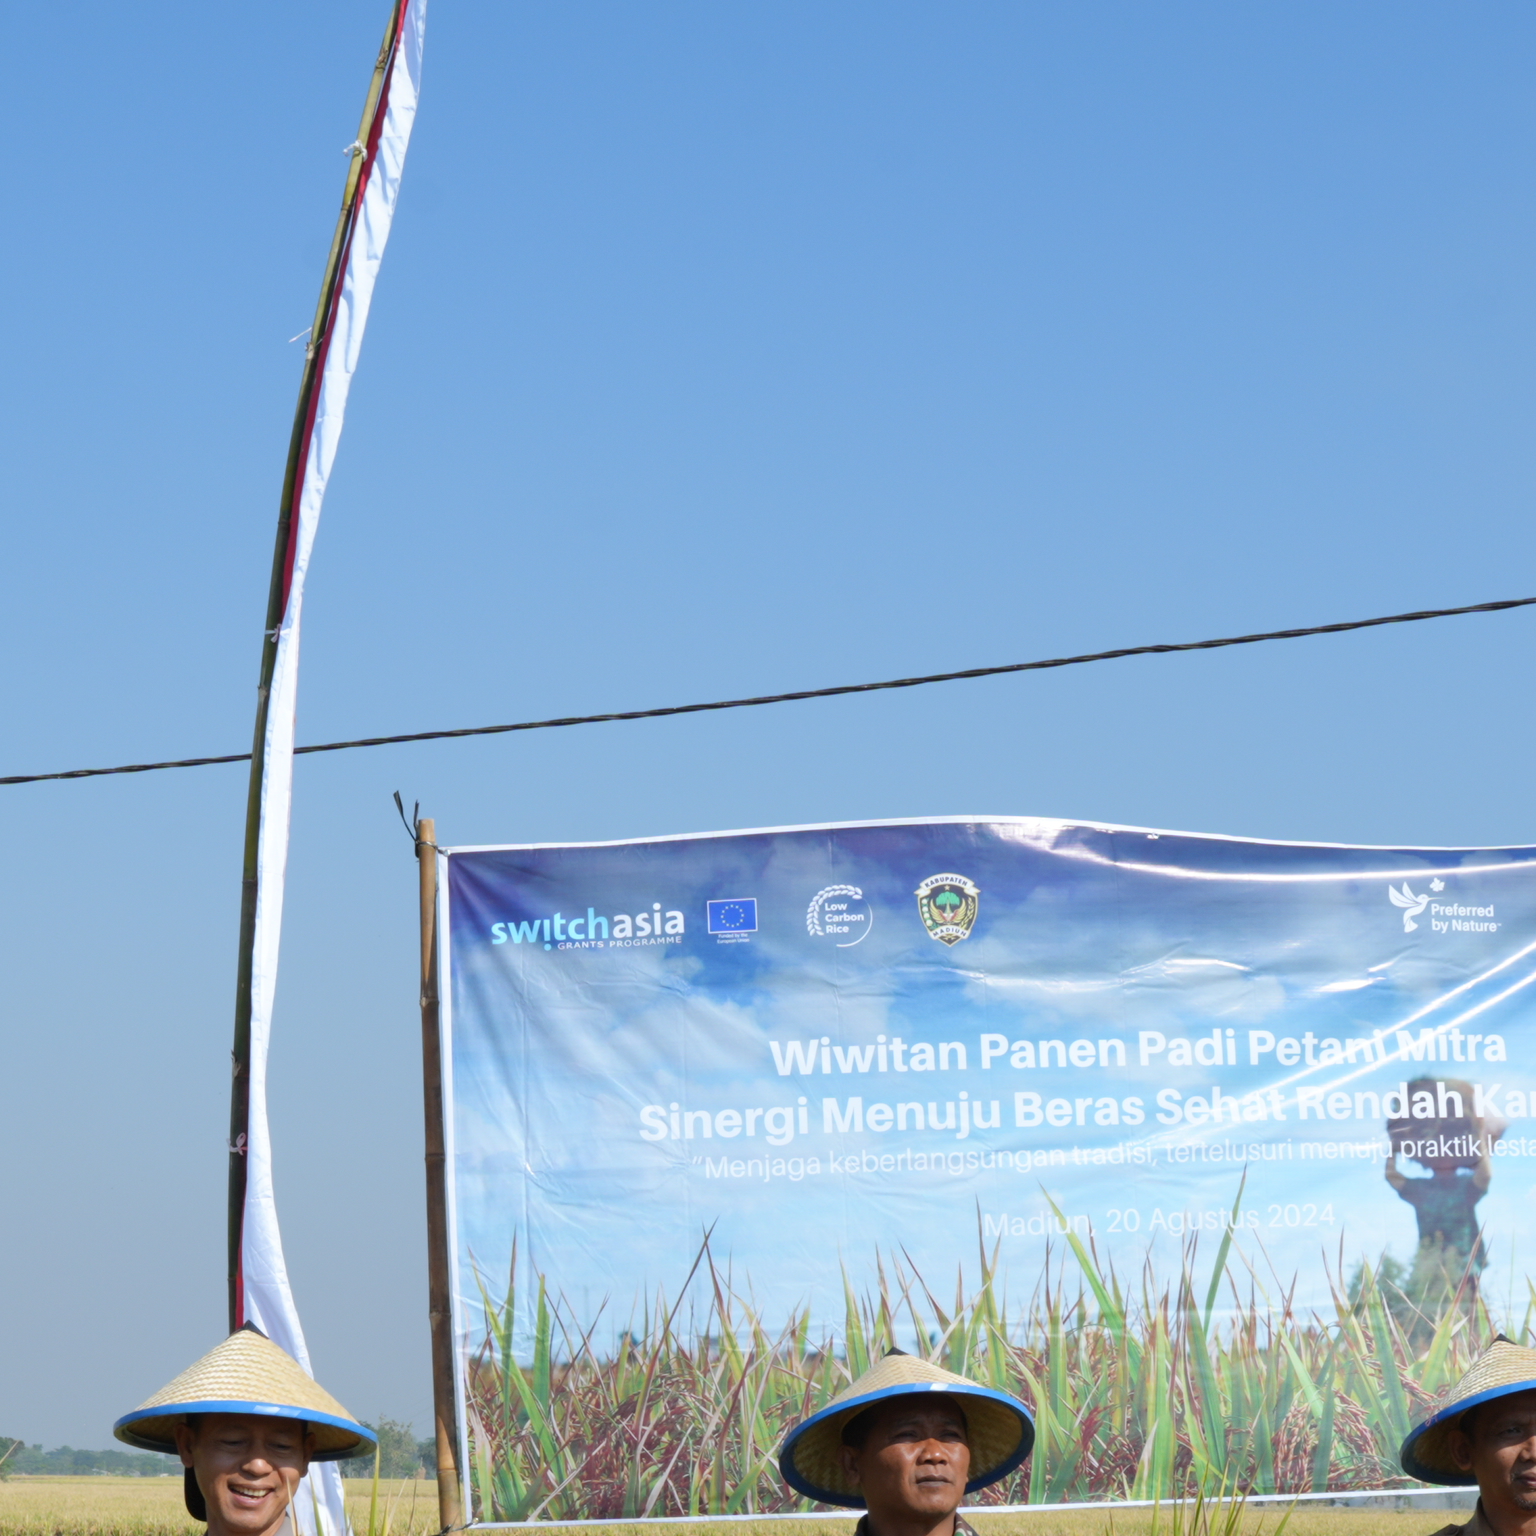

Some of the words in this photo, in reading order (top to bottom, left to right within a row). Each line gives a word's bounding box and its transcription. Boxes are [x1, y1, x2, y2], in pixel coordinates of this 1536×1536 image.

[925, 876, 968, 889] KABUPATEN
[825, 903, 847, 911] Low
[1431, 903, 1494, 917] Preferred
[825, 913, 864, 922] Carbon
[826, 924, 849, 933] Rice
[932, 928, 967, 937] MADIUN
[1432, 918, 1449, 934] by
[557, 941, 604, 951] GRANTS
[609, 936, 683, 948] PROGRAMME
[769, 1034, 967, 1077] Wiwitan
[980, 1033, 1127, 1070] Panen
[1138, 1028, 1237, 1067] Padi
[1248, 1028, 1385, 1066] Petani
[1395, 1028, 1508, 1064] Mitra
[638, 1097, 810, 1147] Sinergi
[822, 1091, 1001, 1139] Menuju
[1014, 1090, 1145, 1128] Beras
[1155, 1086, 1287, 1126] Sehat
[1296, 1083, 1464, 1121] Rendah
[829, 1147, 1066, 1176] keberlangsungan
[1072, 1142, 1158, 1167] tradisi,
[1166, 1138, 1293, 1164] tertelusuri
[1300, 1138, 1394, 1165] menuju
[1400, 1134, 1483, 1164] praktik
[984, 1210, 1098, 1238] Madiun,
[1105, 1208, 1140, 1234] 20
[1149, 1205, 1260, 1238] Agustus
[1267, 1203, 1336, 1229] 2024
